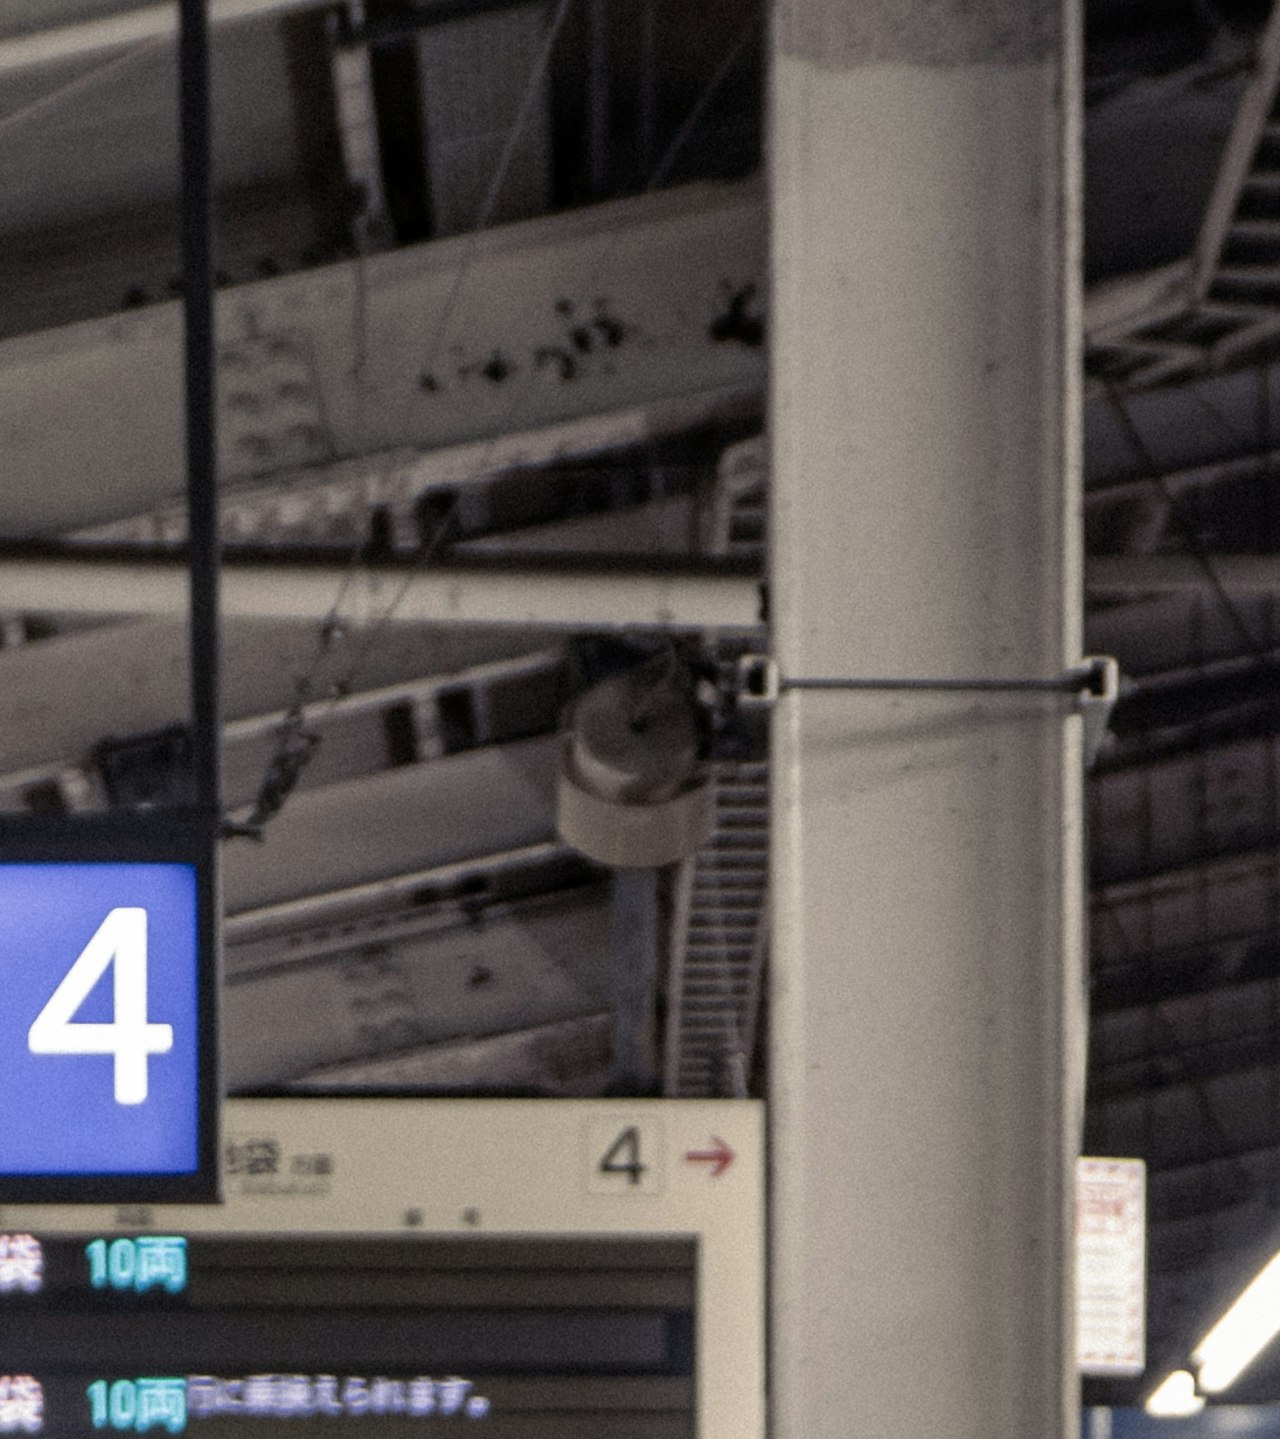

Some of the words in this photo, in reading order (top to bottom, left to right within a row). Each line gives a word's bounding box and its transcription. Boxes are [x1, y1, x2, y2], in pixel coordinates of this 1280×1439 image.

[28, 906, 173, 1105] 4
[599, 1124, 647, 1186] 4
[86, 1236, 187, 1292] 10両
[87, 1377, 187, 1433] 10両
